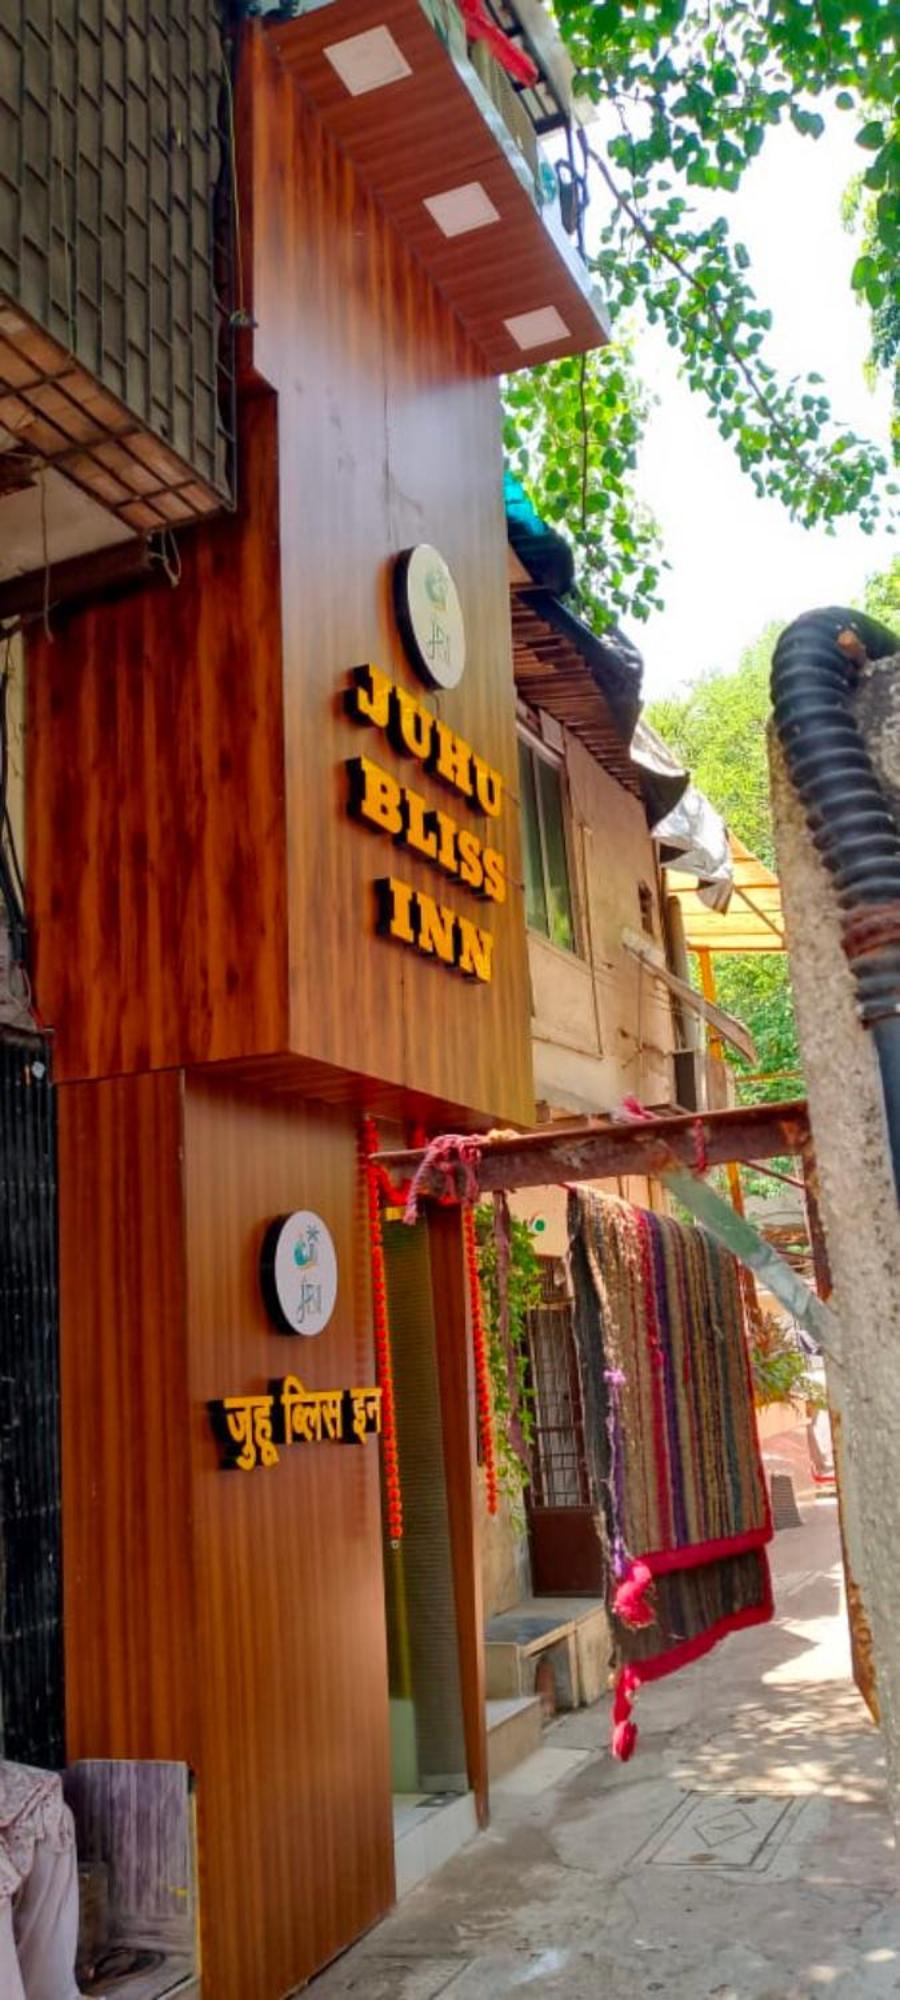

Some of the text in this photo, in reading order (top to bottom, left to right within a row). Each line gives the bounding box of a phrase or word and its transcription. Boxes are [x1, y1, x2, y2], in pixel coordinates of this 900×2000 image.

[356, 664, 503, 817] JUHU
[360, 754, 505, 903] BLISS
[389, 876, 494, 983] INN
[223, 1374, 382, 1471] जुहू ब्लिस इन
